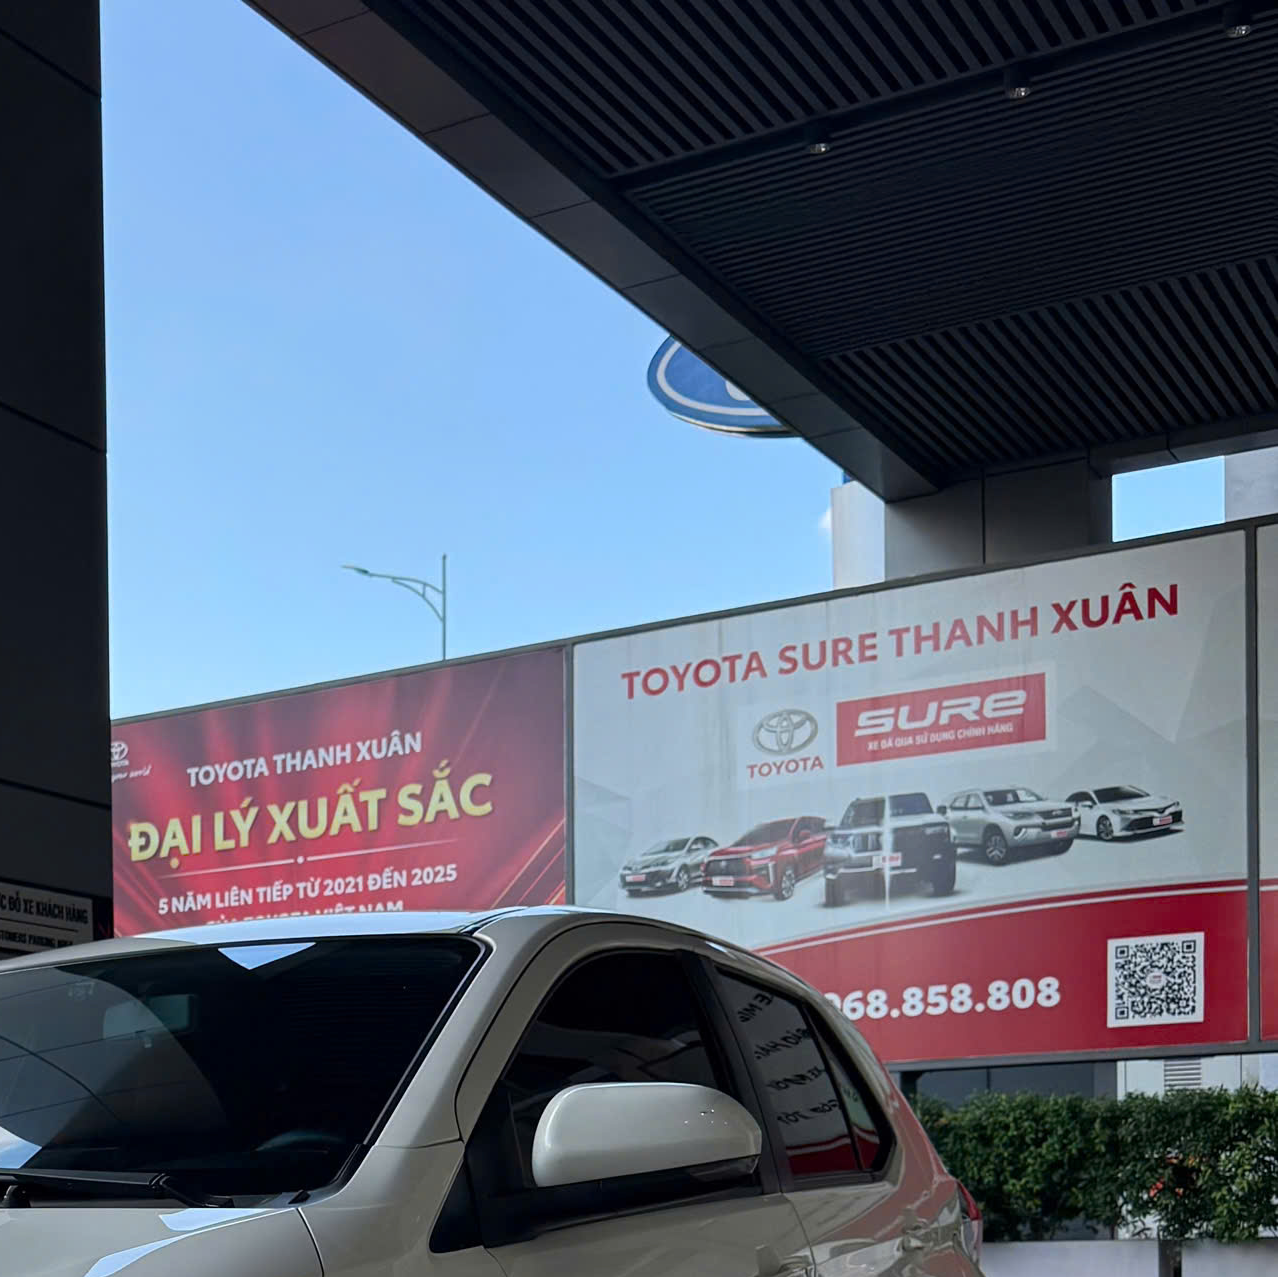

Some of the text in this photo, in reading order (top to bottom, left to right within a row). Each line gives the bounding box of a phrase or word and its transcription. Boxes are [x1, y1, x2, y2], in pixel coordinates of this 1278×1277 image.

[620, 581, 1179, 700] TOYOTA SURE THANH XUÂN
[187, 758, 269, 787] TOYOTA
[273, 744, 352, 776] THANH
[356, 730, 422, 762] XUÂN
[747, 756, 824, 779] TOYOTA
[128, 758, 494, 870] ĐẠI LÝ XUẤT SẮC
[23, 899, 35, 915] XE
[157, 863, 458, 916] 5 NĂM LIÊN TIẾP TỪ 2021 ĐẾN 2025
